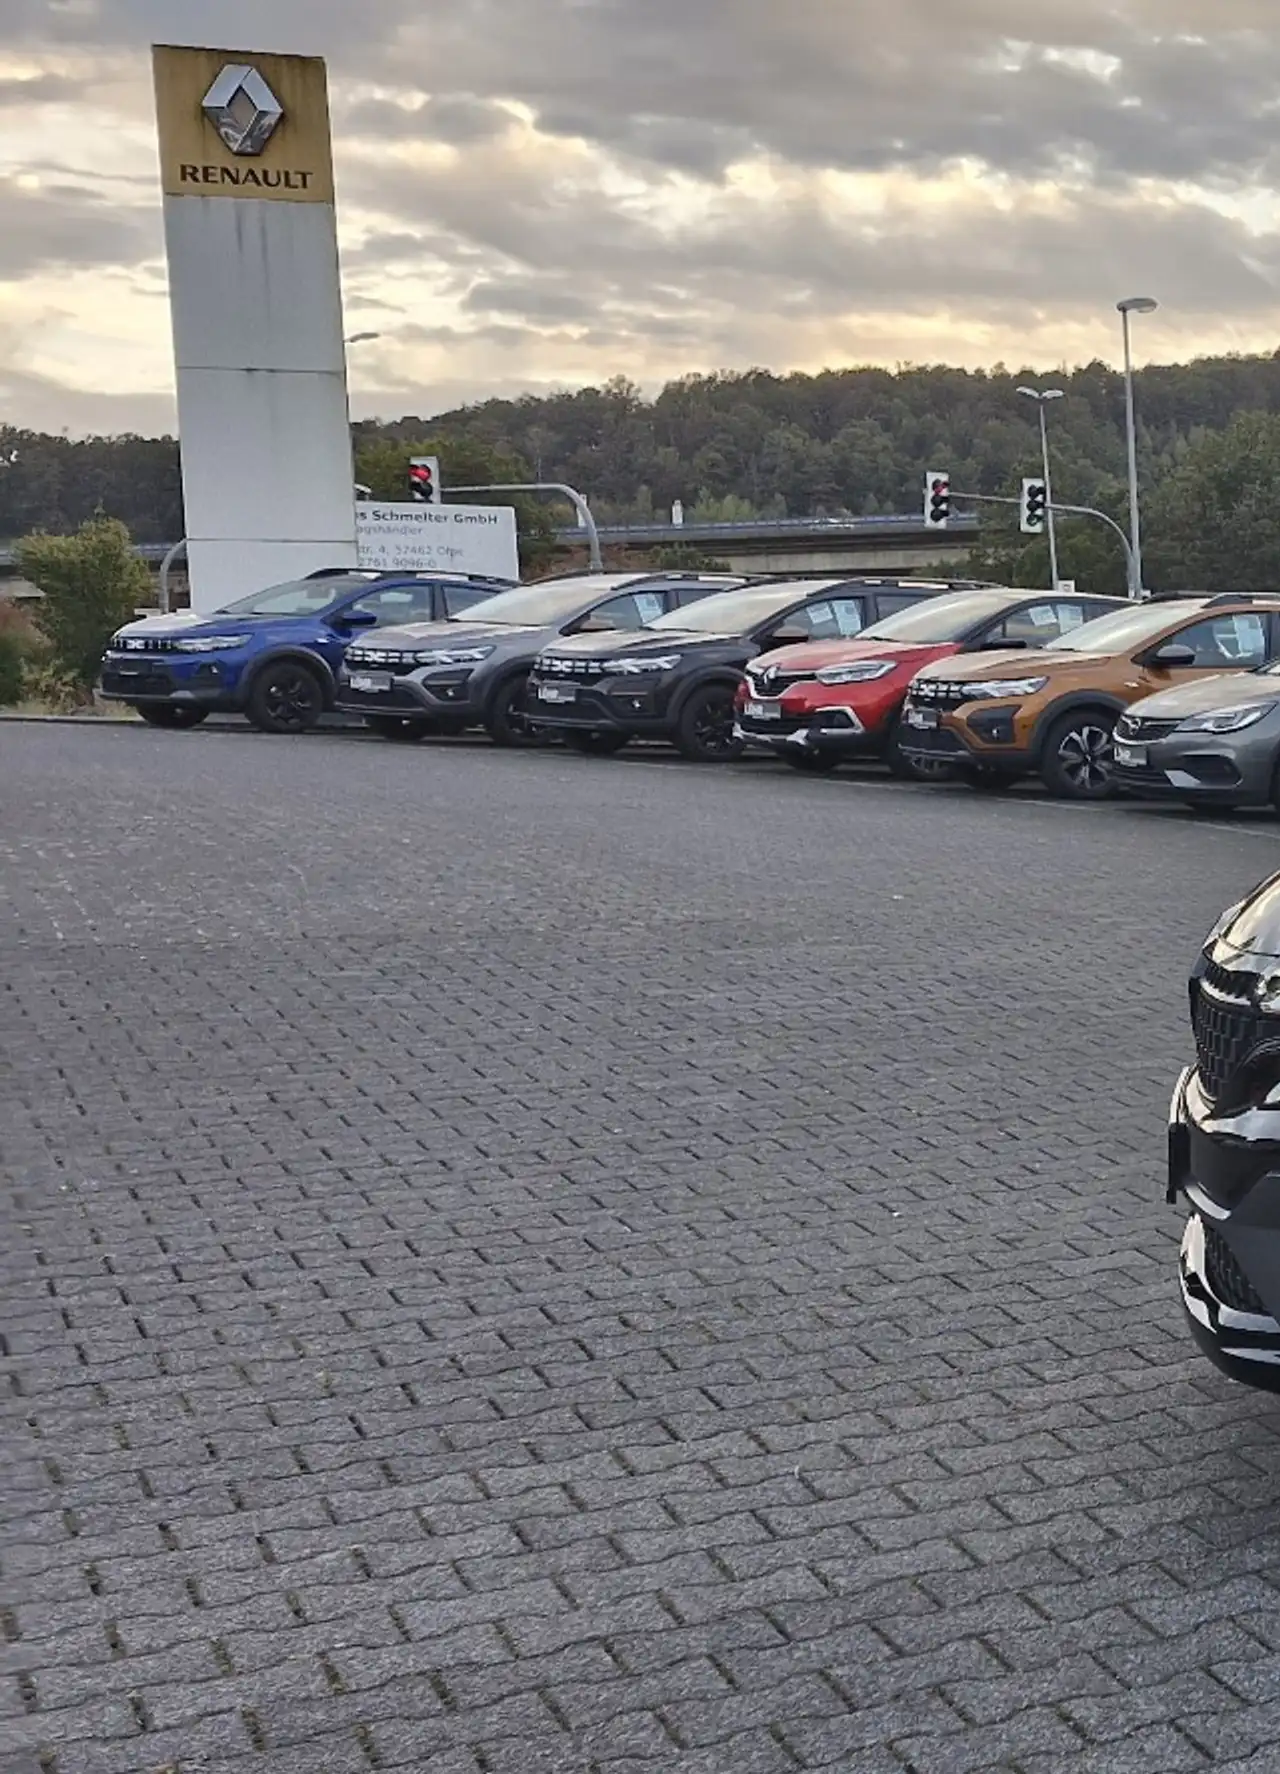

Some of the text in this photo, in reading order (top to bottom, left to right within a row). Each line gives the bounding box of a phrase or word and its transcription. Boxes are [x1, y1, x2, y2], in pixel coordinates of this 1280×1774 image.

[180, 163, 313, 189] RENAULT
[372, 509, 448, 524] Schmelter
[453, 512, 498, 525] GmbH
